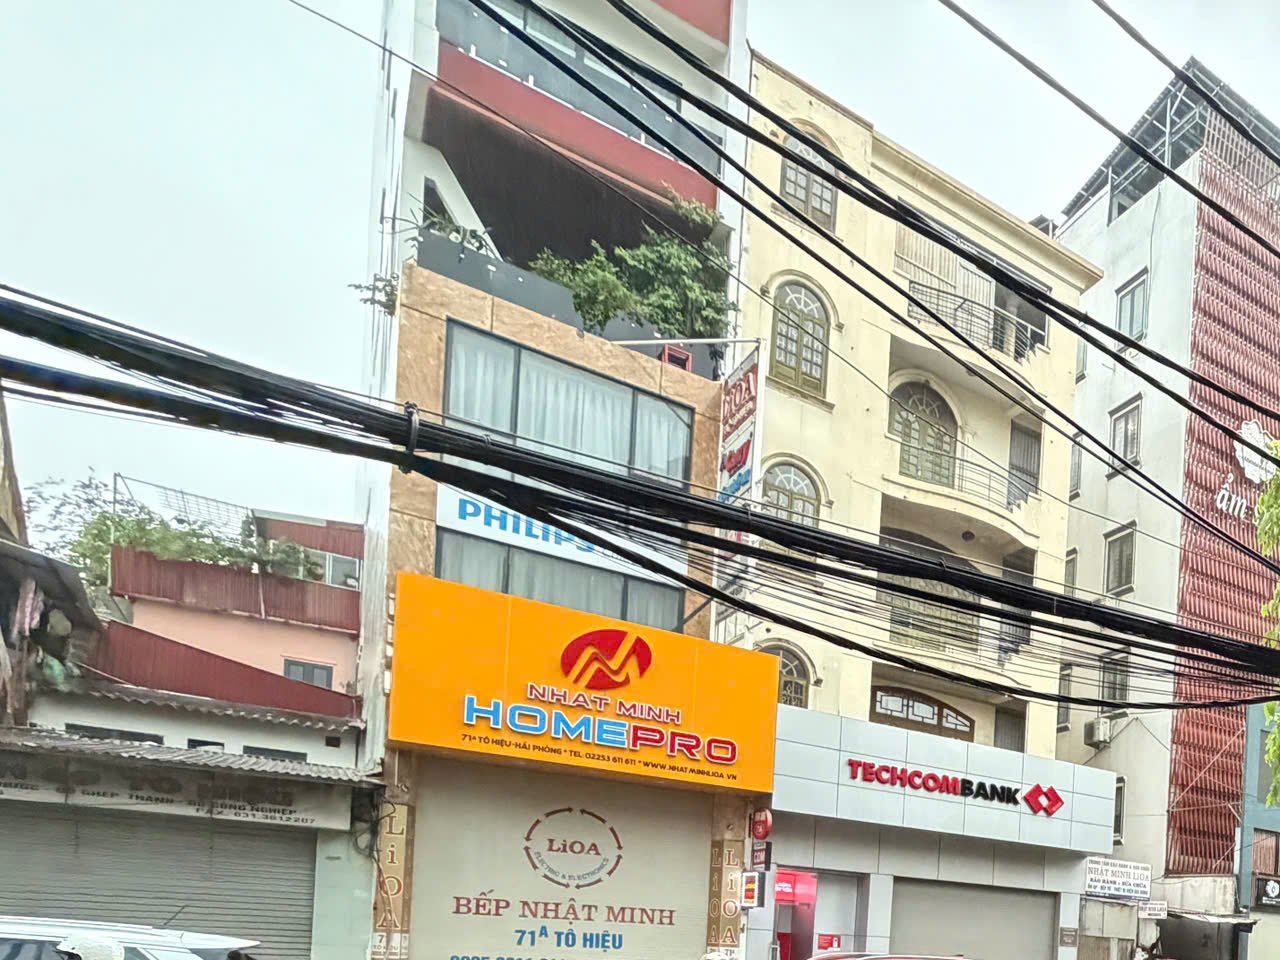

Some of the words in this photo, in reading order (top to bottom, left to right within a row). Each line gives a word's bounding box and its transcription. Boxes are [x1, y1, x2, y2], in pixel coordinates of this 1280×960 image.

[616, 699, 682, 725] MINH
[463, 694, 738, 765] HOMEPRO
[848, 758, 1022, 806] TECHCOMBANK
[546, 838, 602, 857] LiOA
[1110, 869, 1131, 880] MINH
[452, 889, 511, 917] BẾP
[518, 897, 598, 925] NHẬT
[605, 905, 677, 926] MINH
[514, 925, 549, 947] 71A
[554, 928, 577, 948] TÔ
[582, 930, 624, 952] HIỆU
